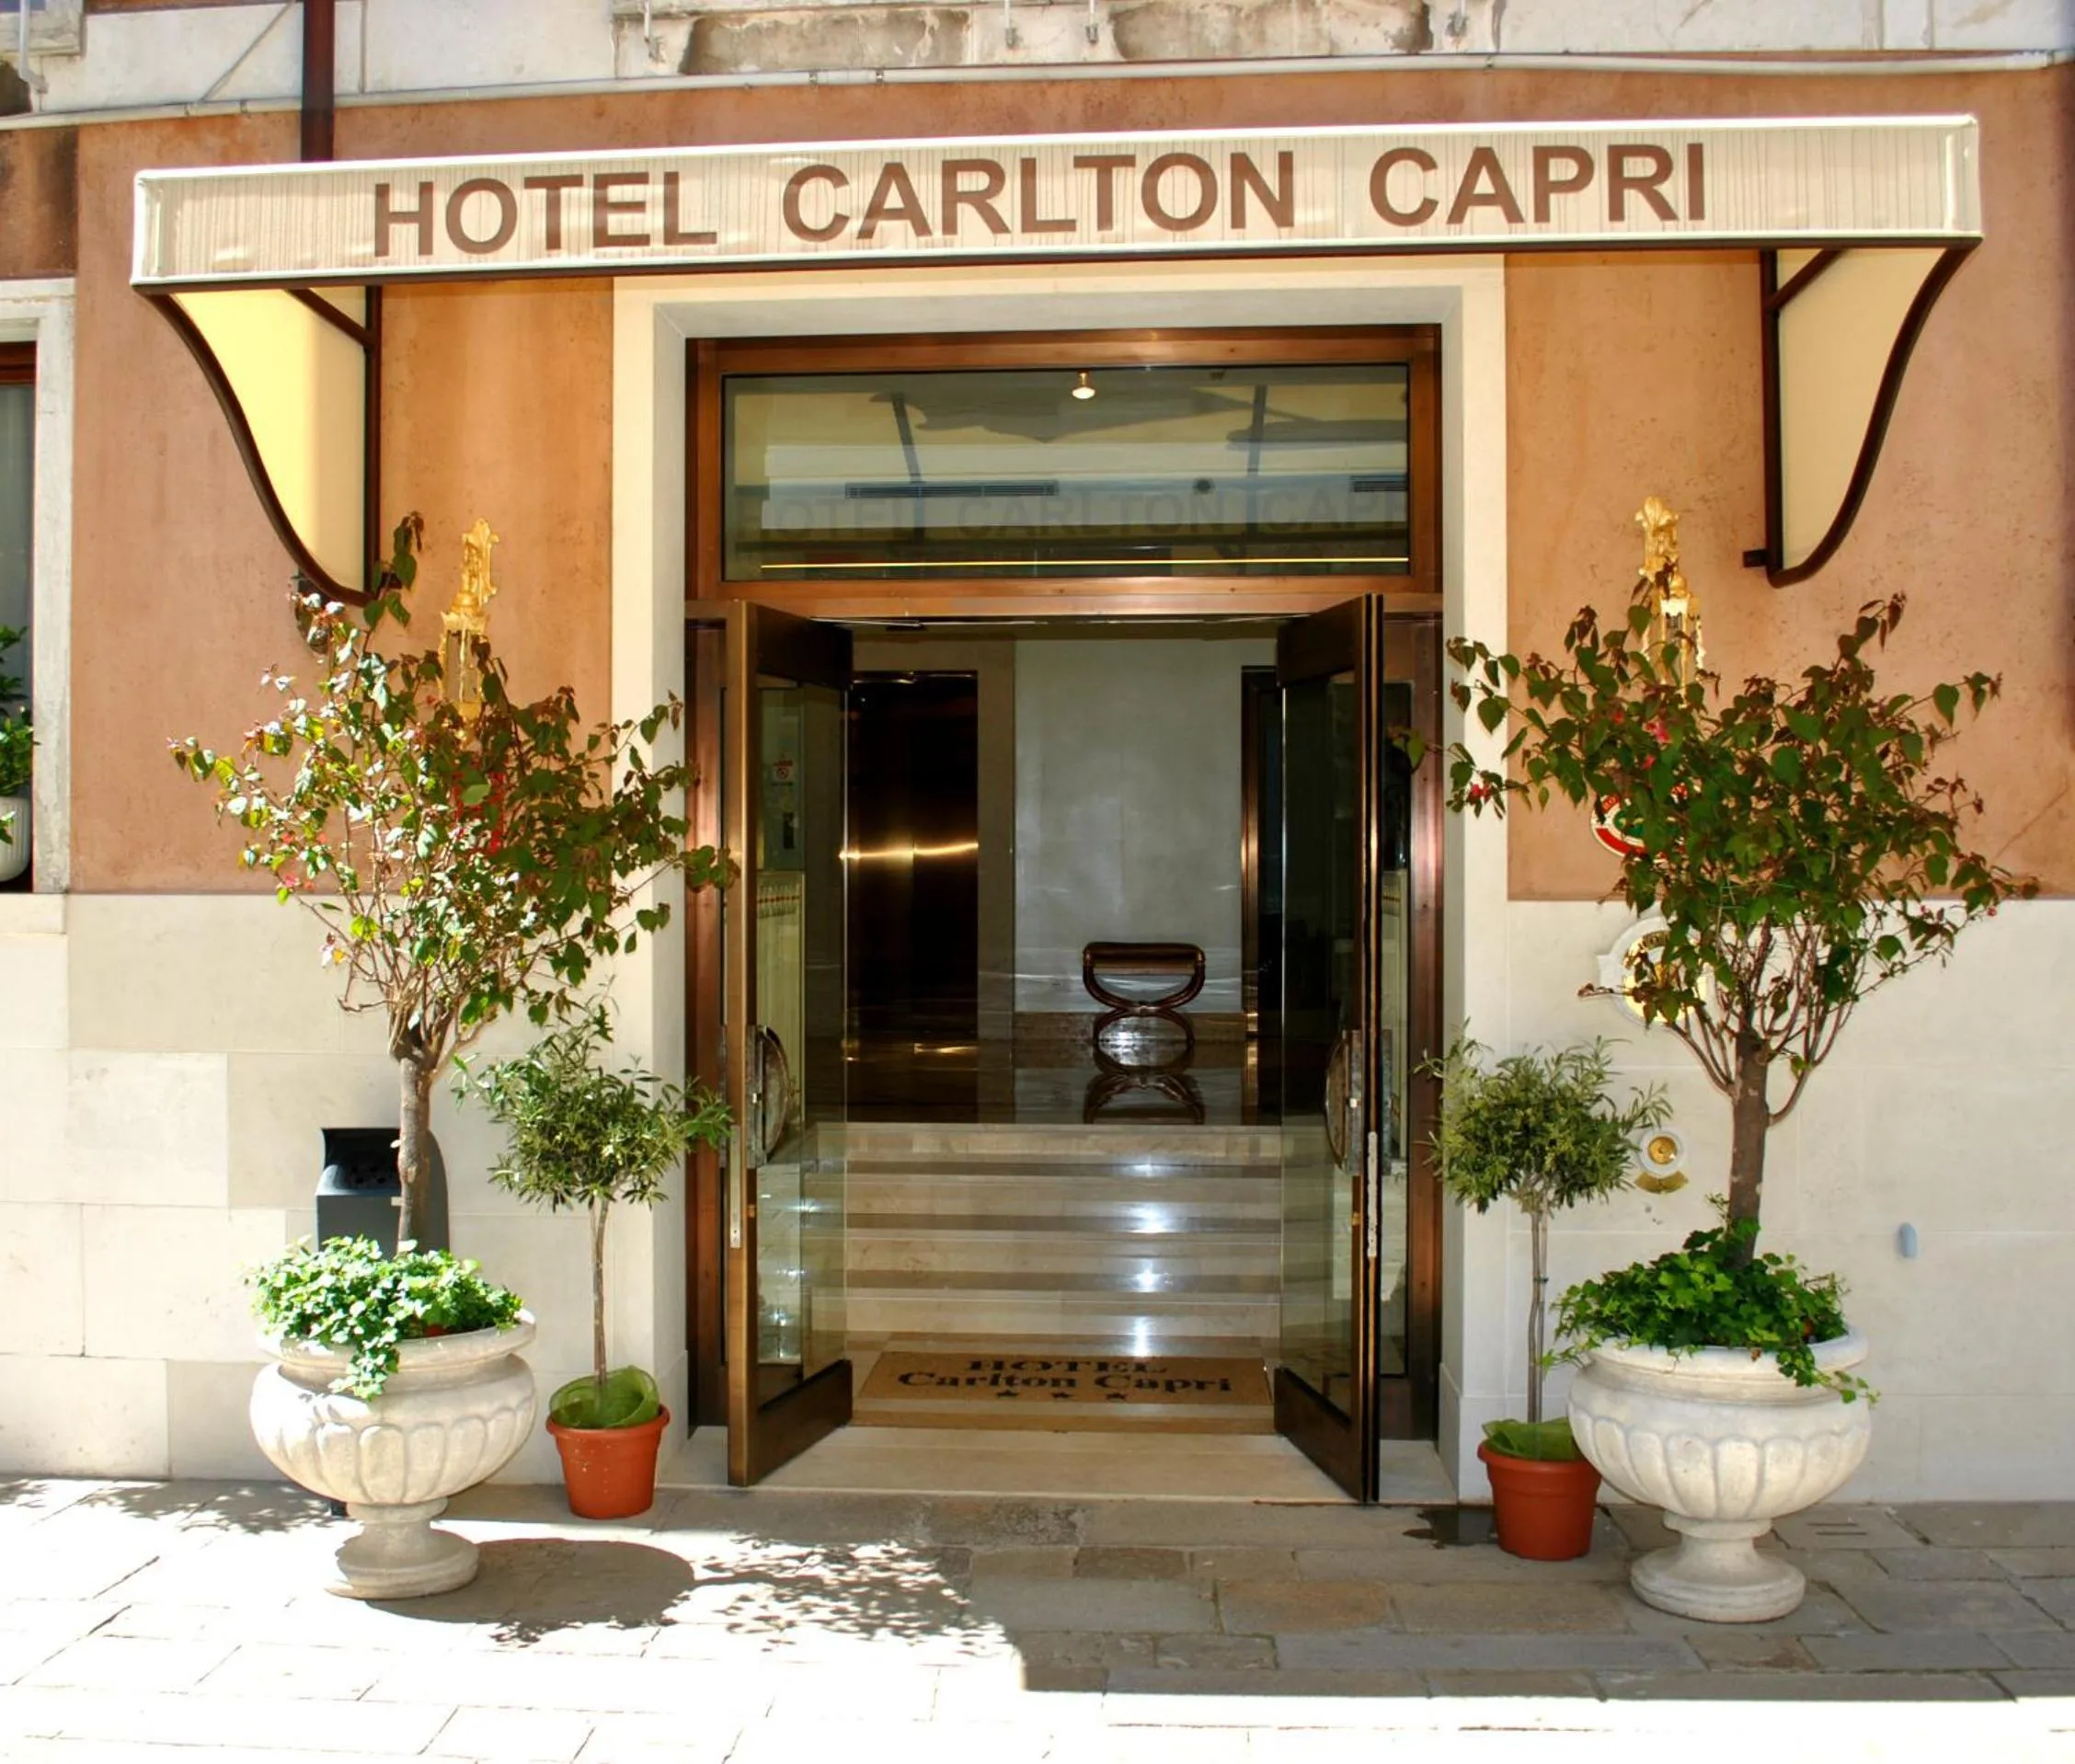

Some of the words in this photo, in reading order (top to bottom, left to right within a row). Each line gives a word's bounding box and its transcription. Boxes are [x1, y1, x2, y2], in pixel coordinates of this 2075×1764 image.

[374, 170, 718, 258] HOTEL
[783, 152, 1294, 241] CARLTON
[1370, 143, 1705, 226] CAPRI
[958, 492, 1223, 537] CARLTON
[898, 1371, 1076, 1388] Carlton
[1094, 1374, 1232, 1392] Capri
[969, 1360, 1166, 1373] HOTEL
